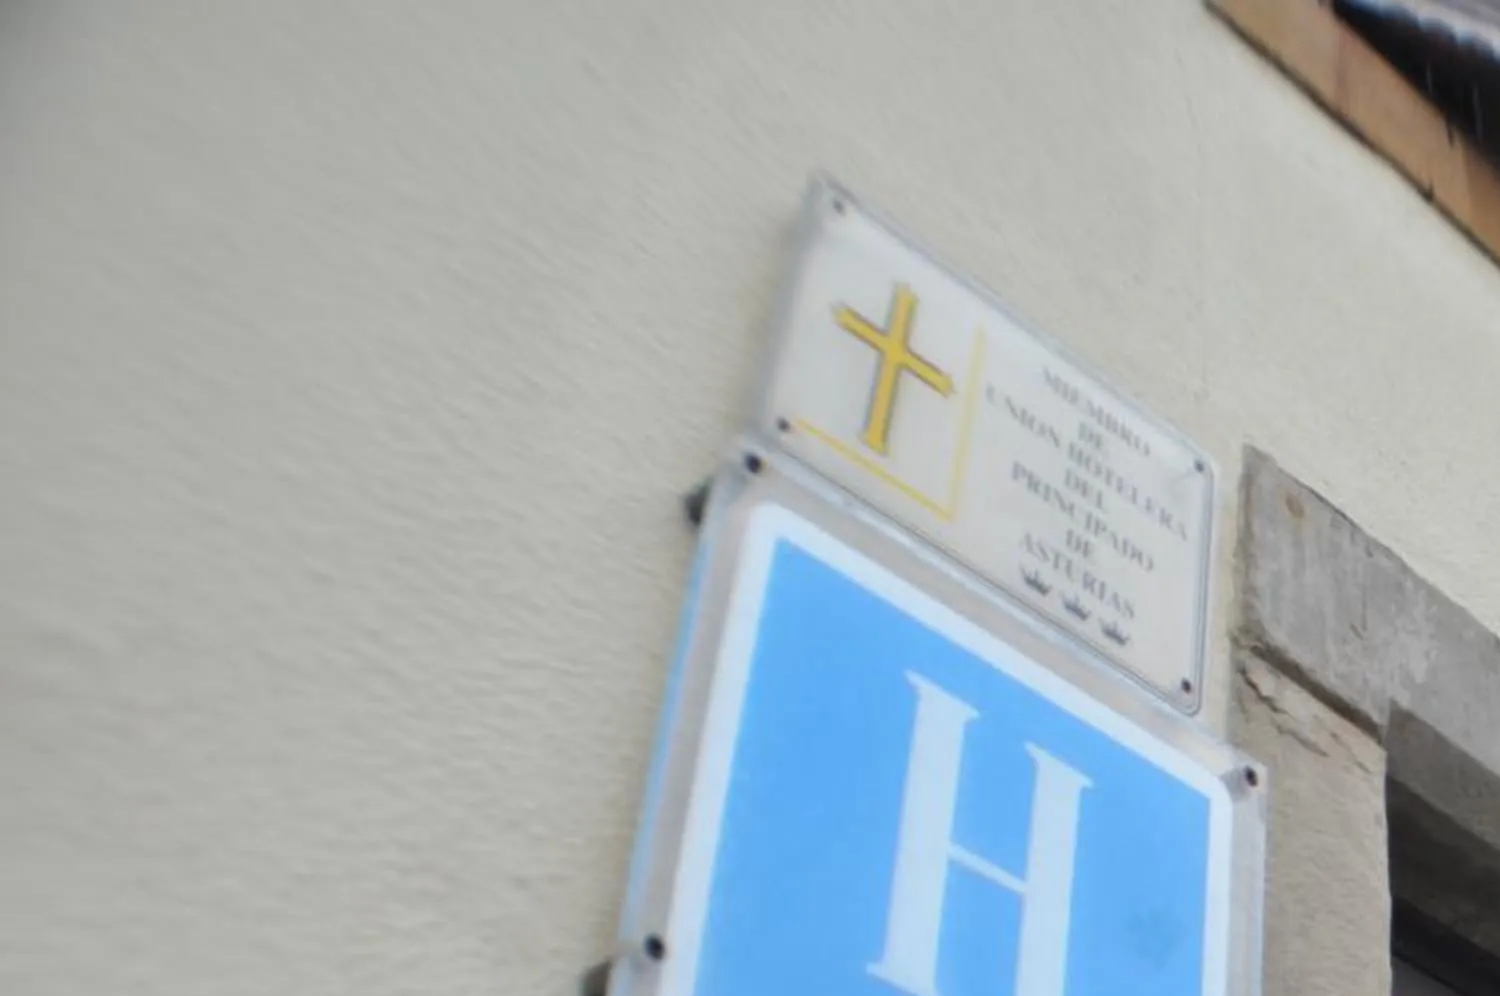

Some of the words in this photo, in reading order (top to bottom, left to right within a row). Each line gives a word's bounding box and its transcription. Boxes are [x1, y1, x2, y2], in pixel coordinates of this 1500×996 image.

[1010, 459, 1156, 573] PRINCIPADO
[1063, 467, 1107, 512] DEL
[1018, 531, 1137, 620] ASTURIAS
[1064, 527, 1094, 560] DE
